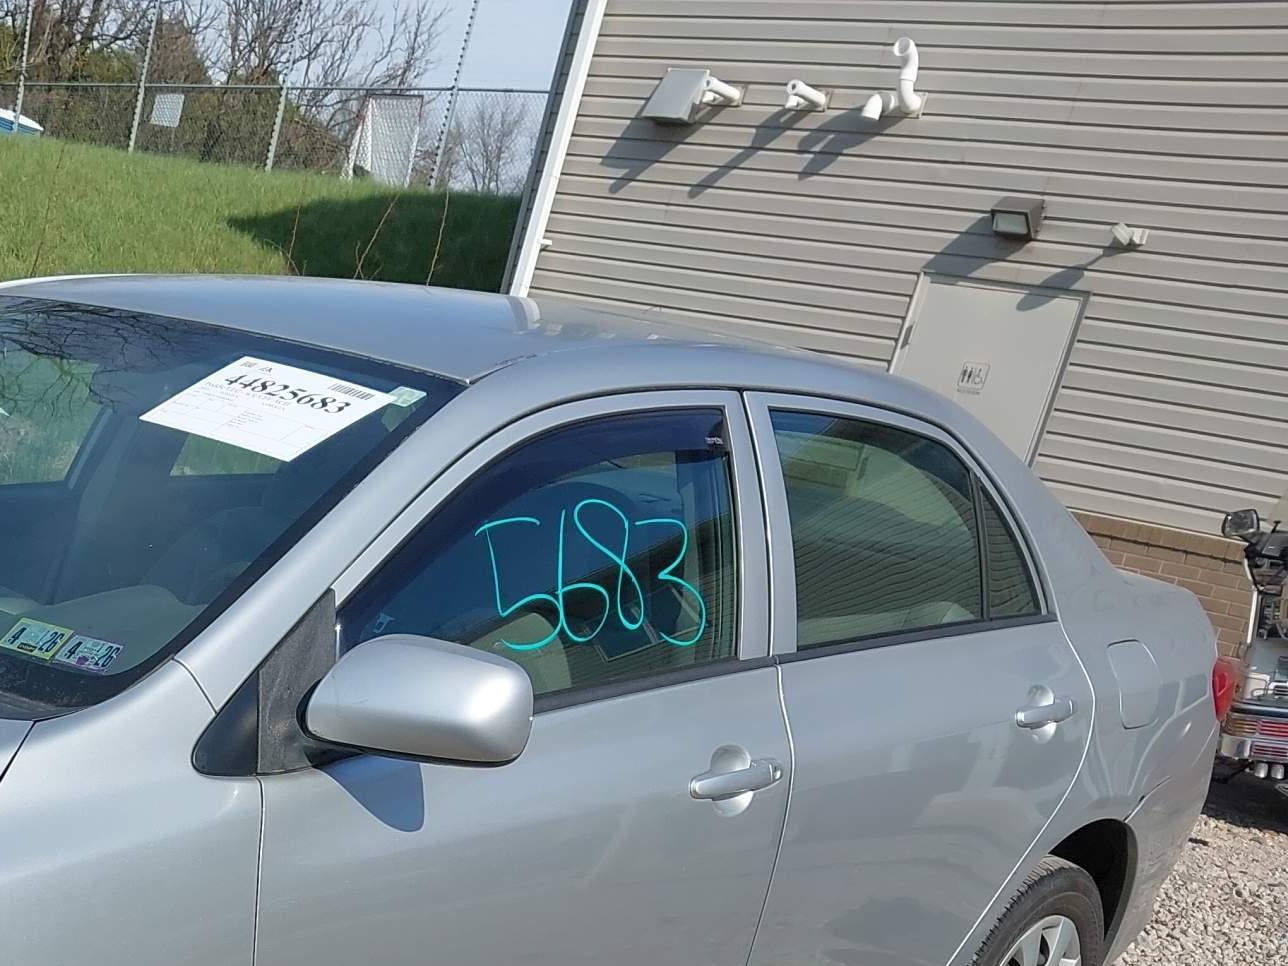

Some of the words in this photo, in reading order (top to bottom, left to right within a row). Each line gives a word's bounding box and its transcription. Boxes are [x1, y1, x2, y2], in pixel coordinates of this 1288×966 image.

[224, 374, 351, 413] 44825683
[474, 499, 706, 651] 5683
[8, 627, 27, 645] 4
[38, 632, 65, 652] 26
[64, 641, 83, 659] 4
